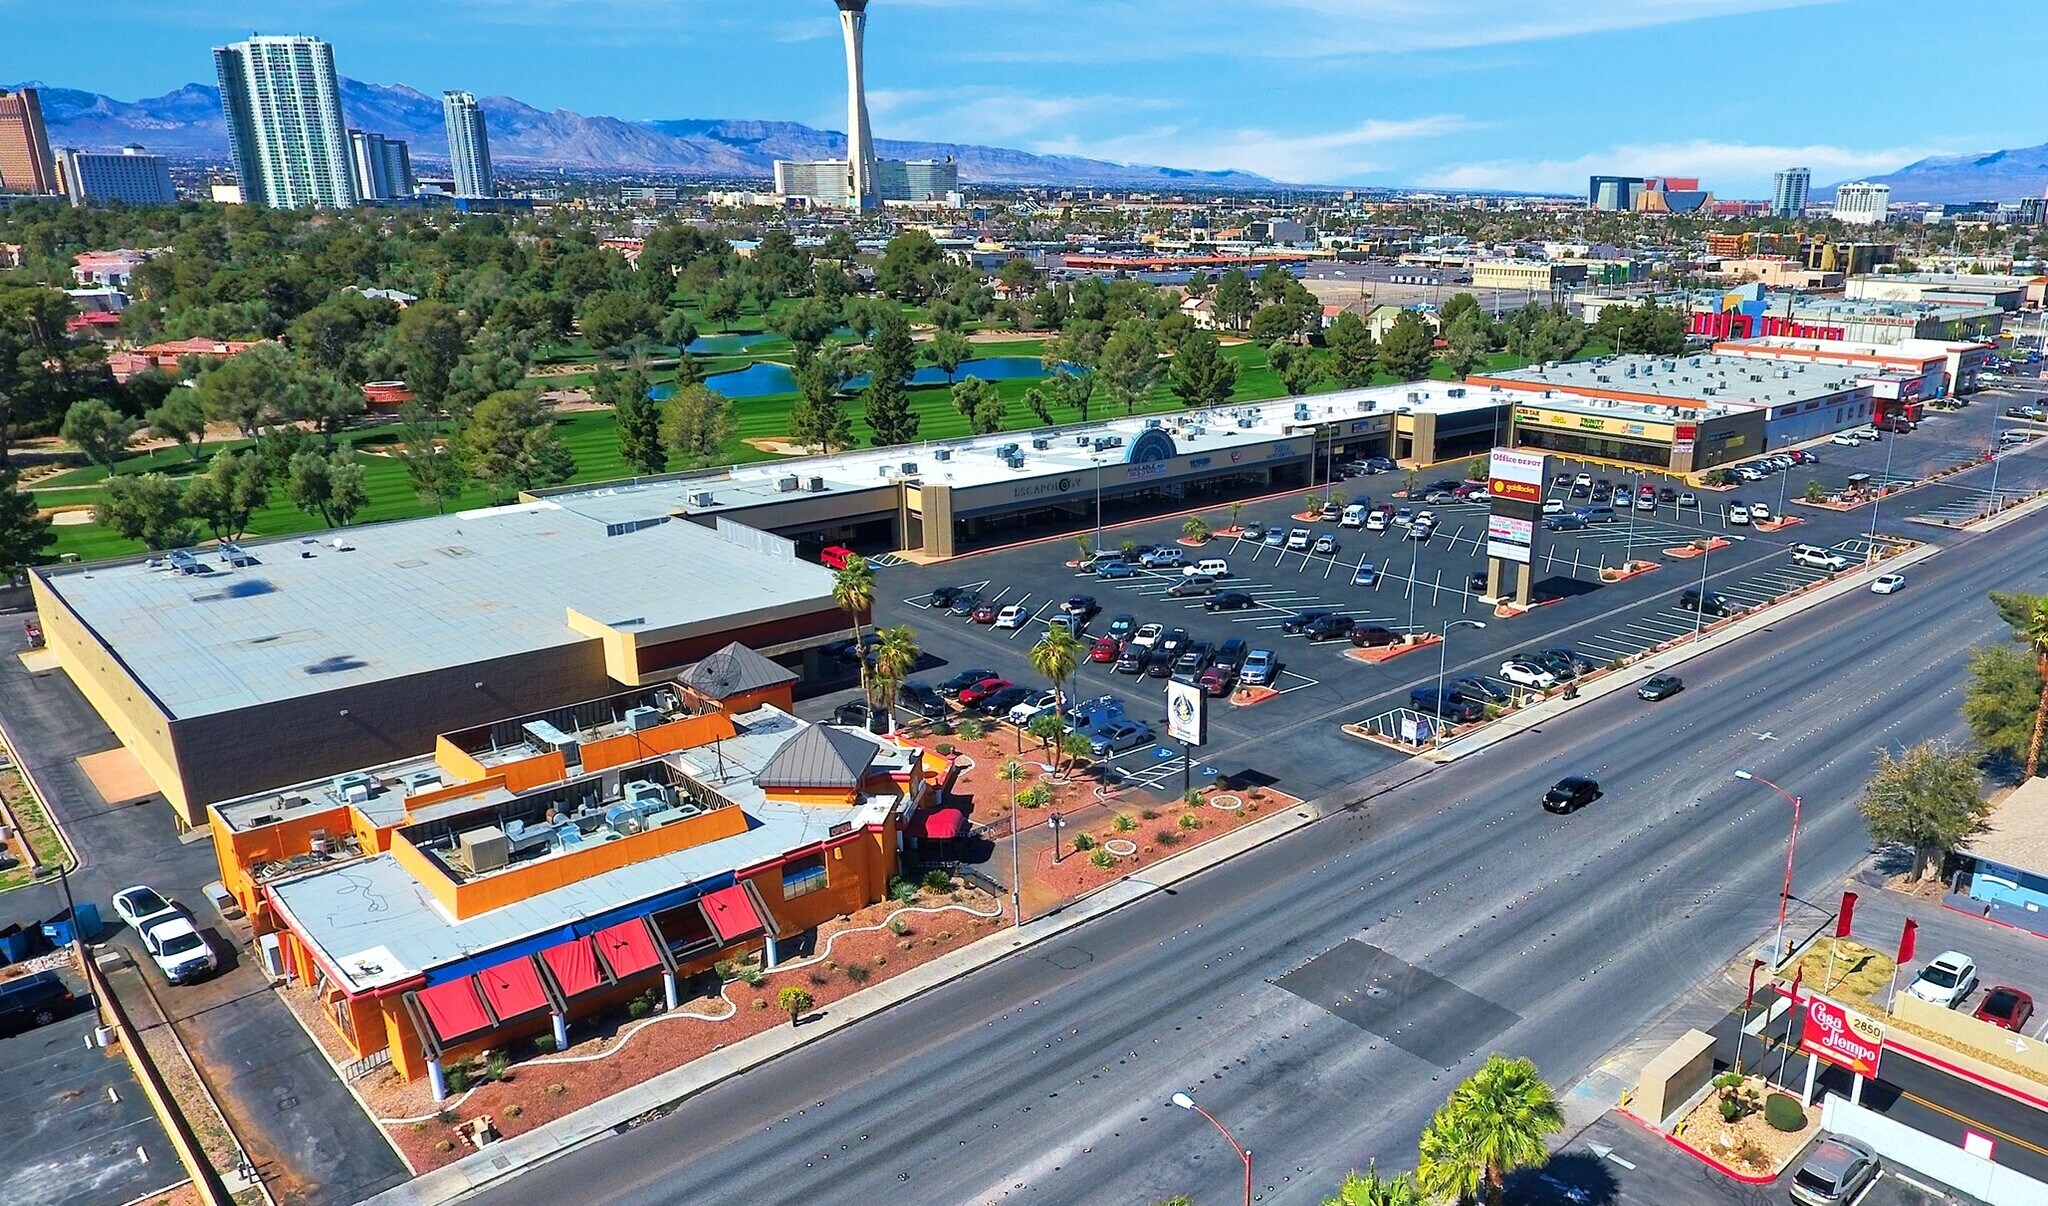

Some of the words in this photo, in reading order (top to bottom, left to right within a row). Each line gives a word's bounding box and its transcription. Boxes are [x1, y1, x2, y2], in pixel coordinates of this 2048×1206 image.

[1493, 453, 1517, 463] Office
[1518, 458, 1542, 467] DEPOT
[1811, 1002, 1843, 1030] Casa
[1853, 1018, 1881, 1037] 2850
[1821, 1022, 1876, 1061] Tiempo
